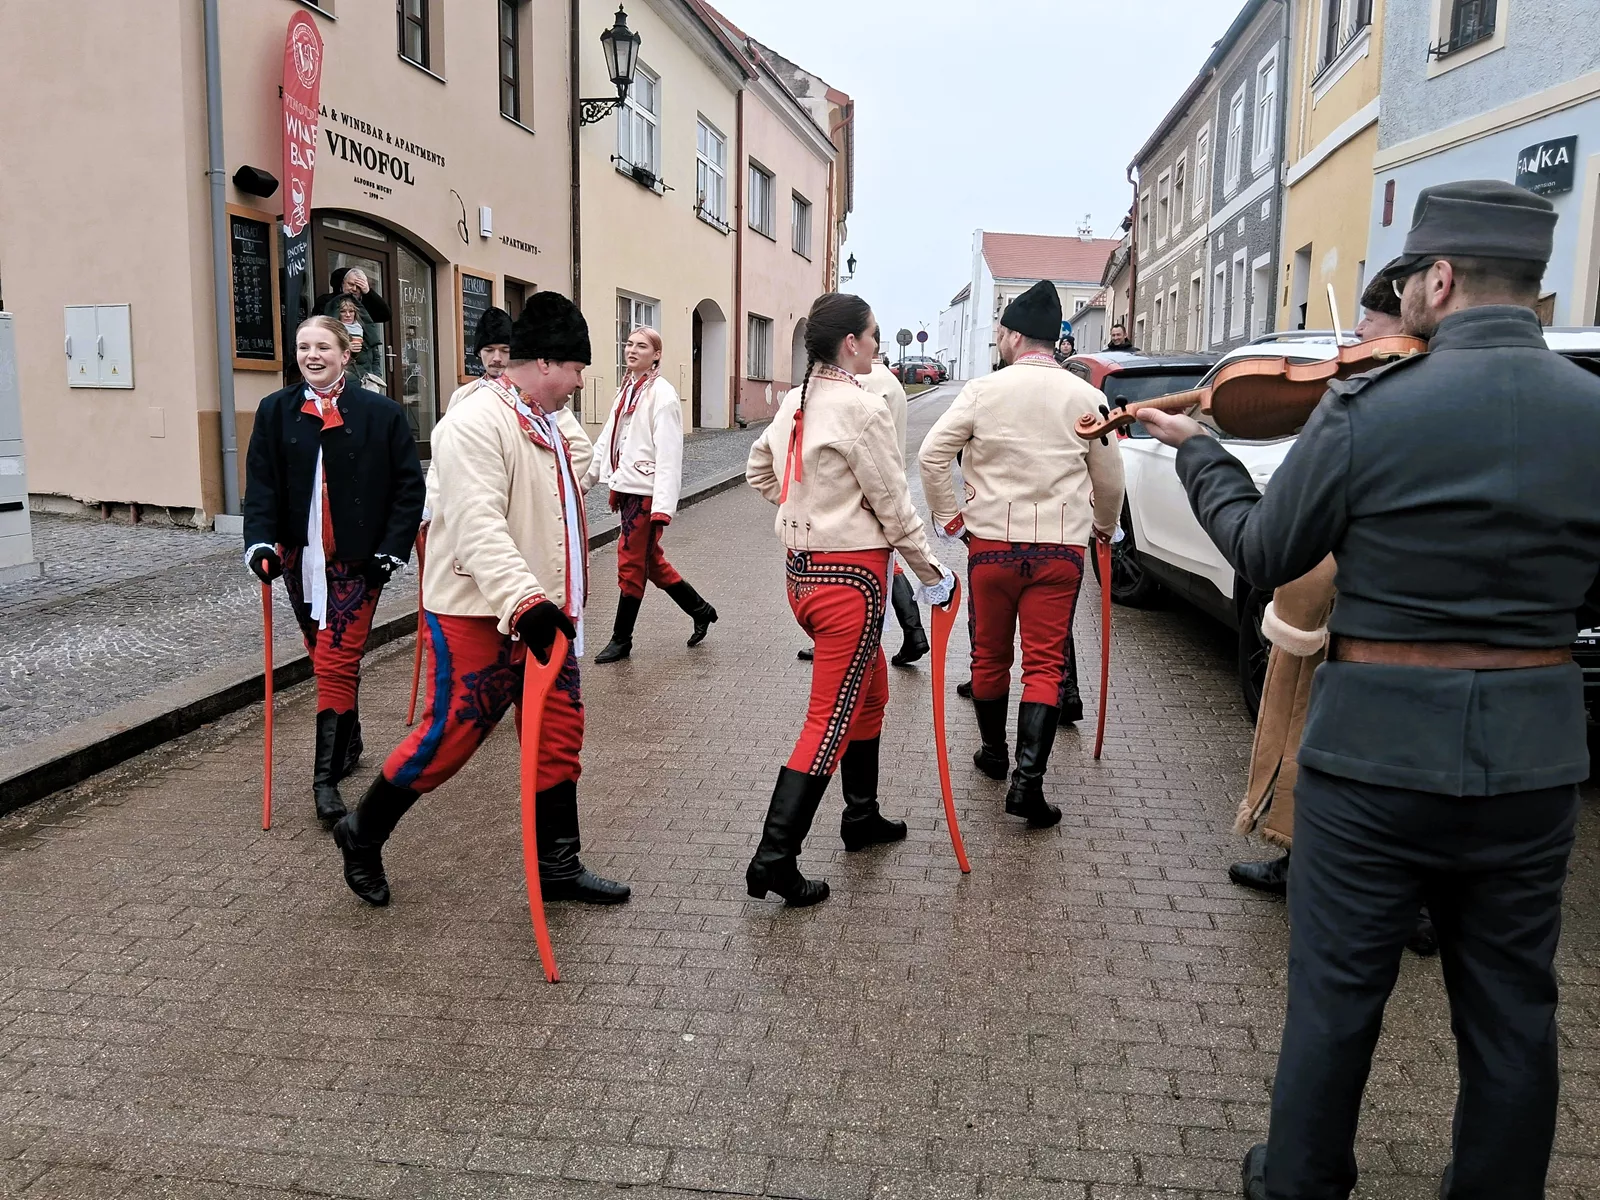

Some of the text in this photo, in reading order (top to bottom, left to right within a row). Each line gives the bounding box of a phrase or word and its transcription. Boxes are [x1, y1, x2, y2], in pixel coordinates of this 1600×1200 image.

[324, 128, 415, 186] VINOFOL
[331, 109, 446, 168] & WINEBAR & APARTMENTS
[398, 278, 427, 308] TERASA
